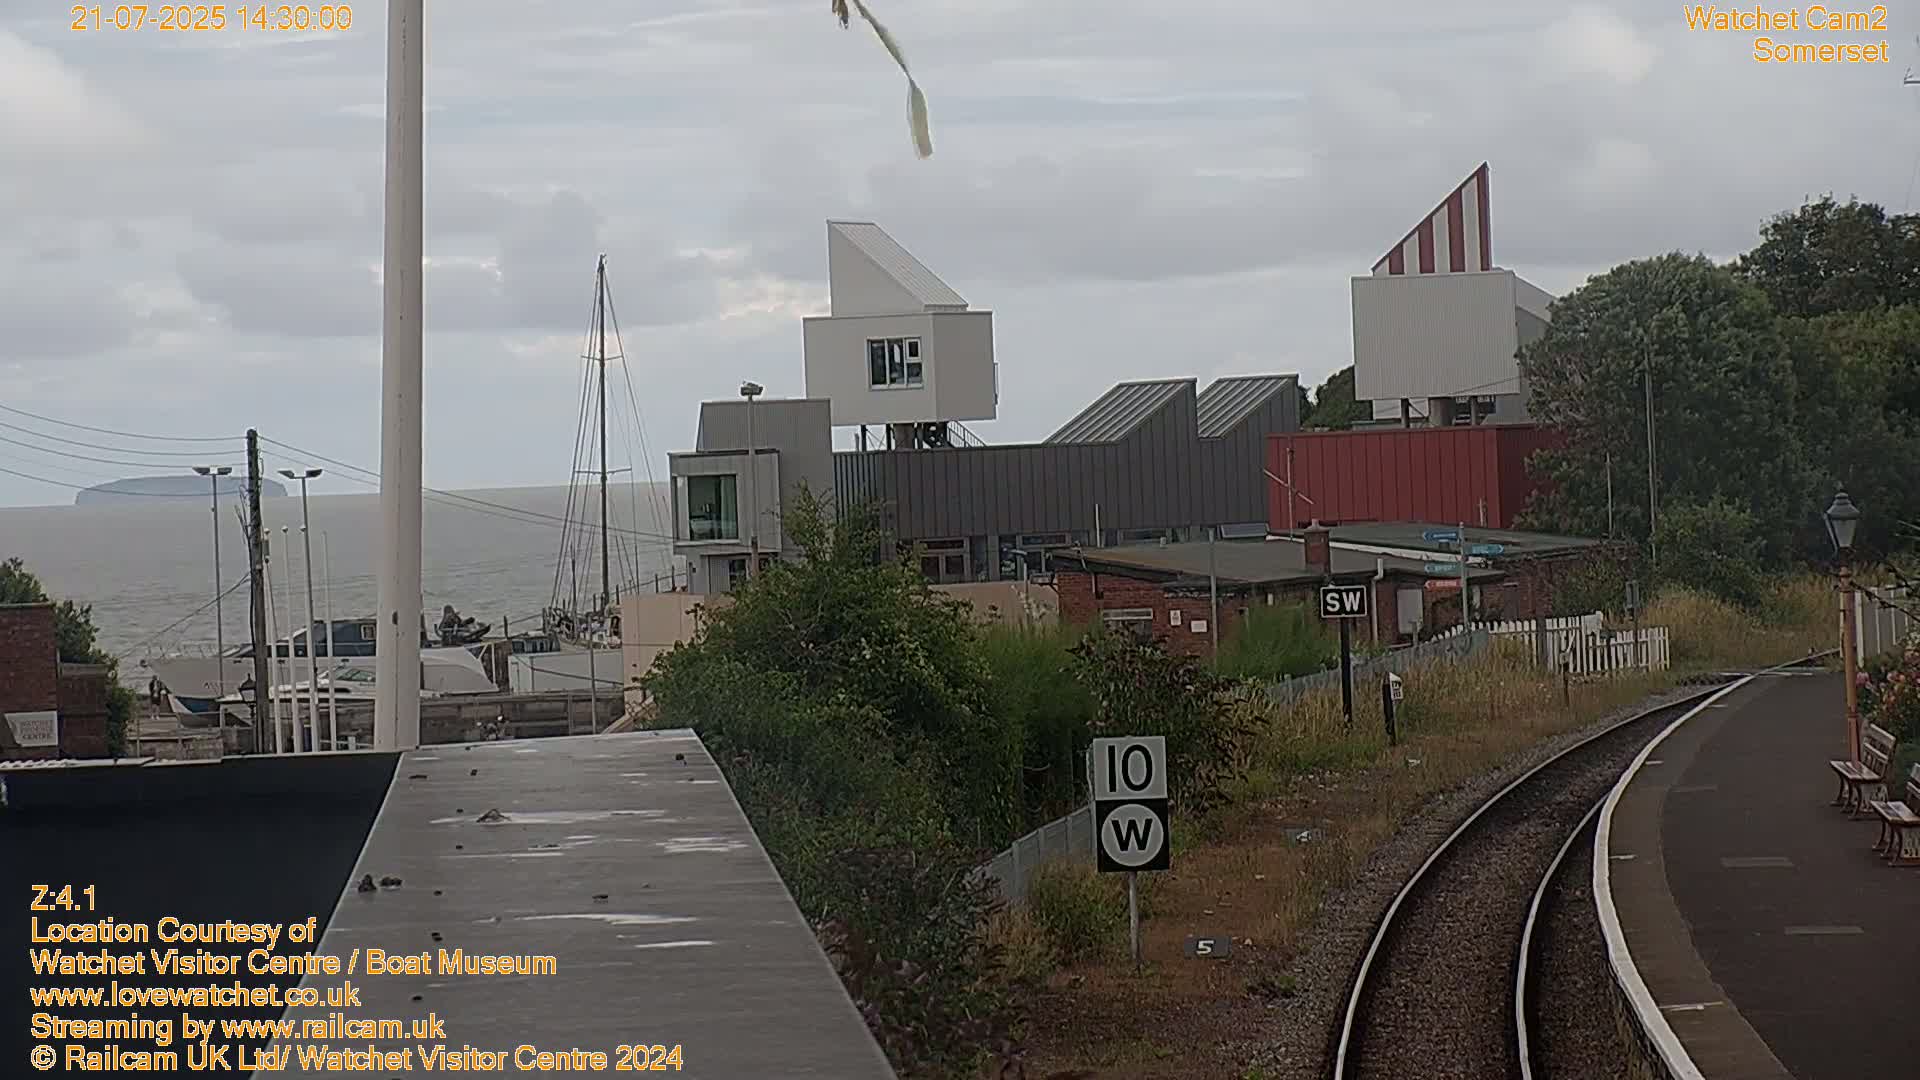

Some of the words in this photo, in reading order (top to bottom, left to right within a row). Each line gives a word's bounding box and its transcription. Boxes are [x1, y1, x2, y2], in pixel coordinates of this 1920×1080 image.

[1326, 591, 1361, 612] SW
[1107, 744, 1153, 793] 10
[1111, 818, 1153, 852] W
[1196, 940, 1215, 955] 5
